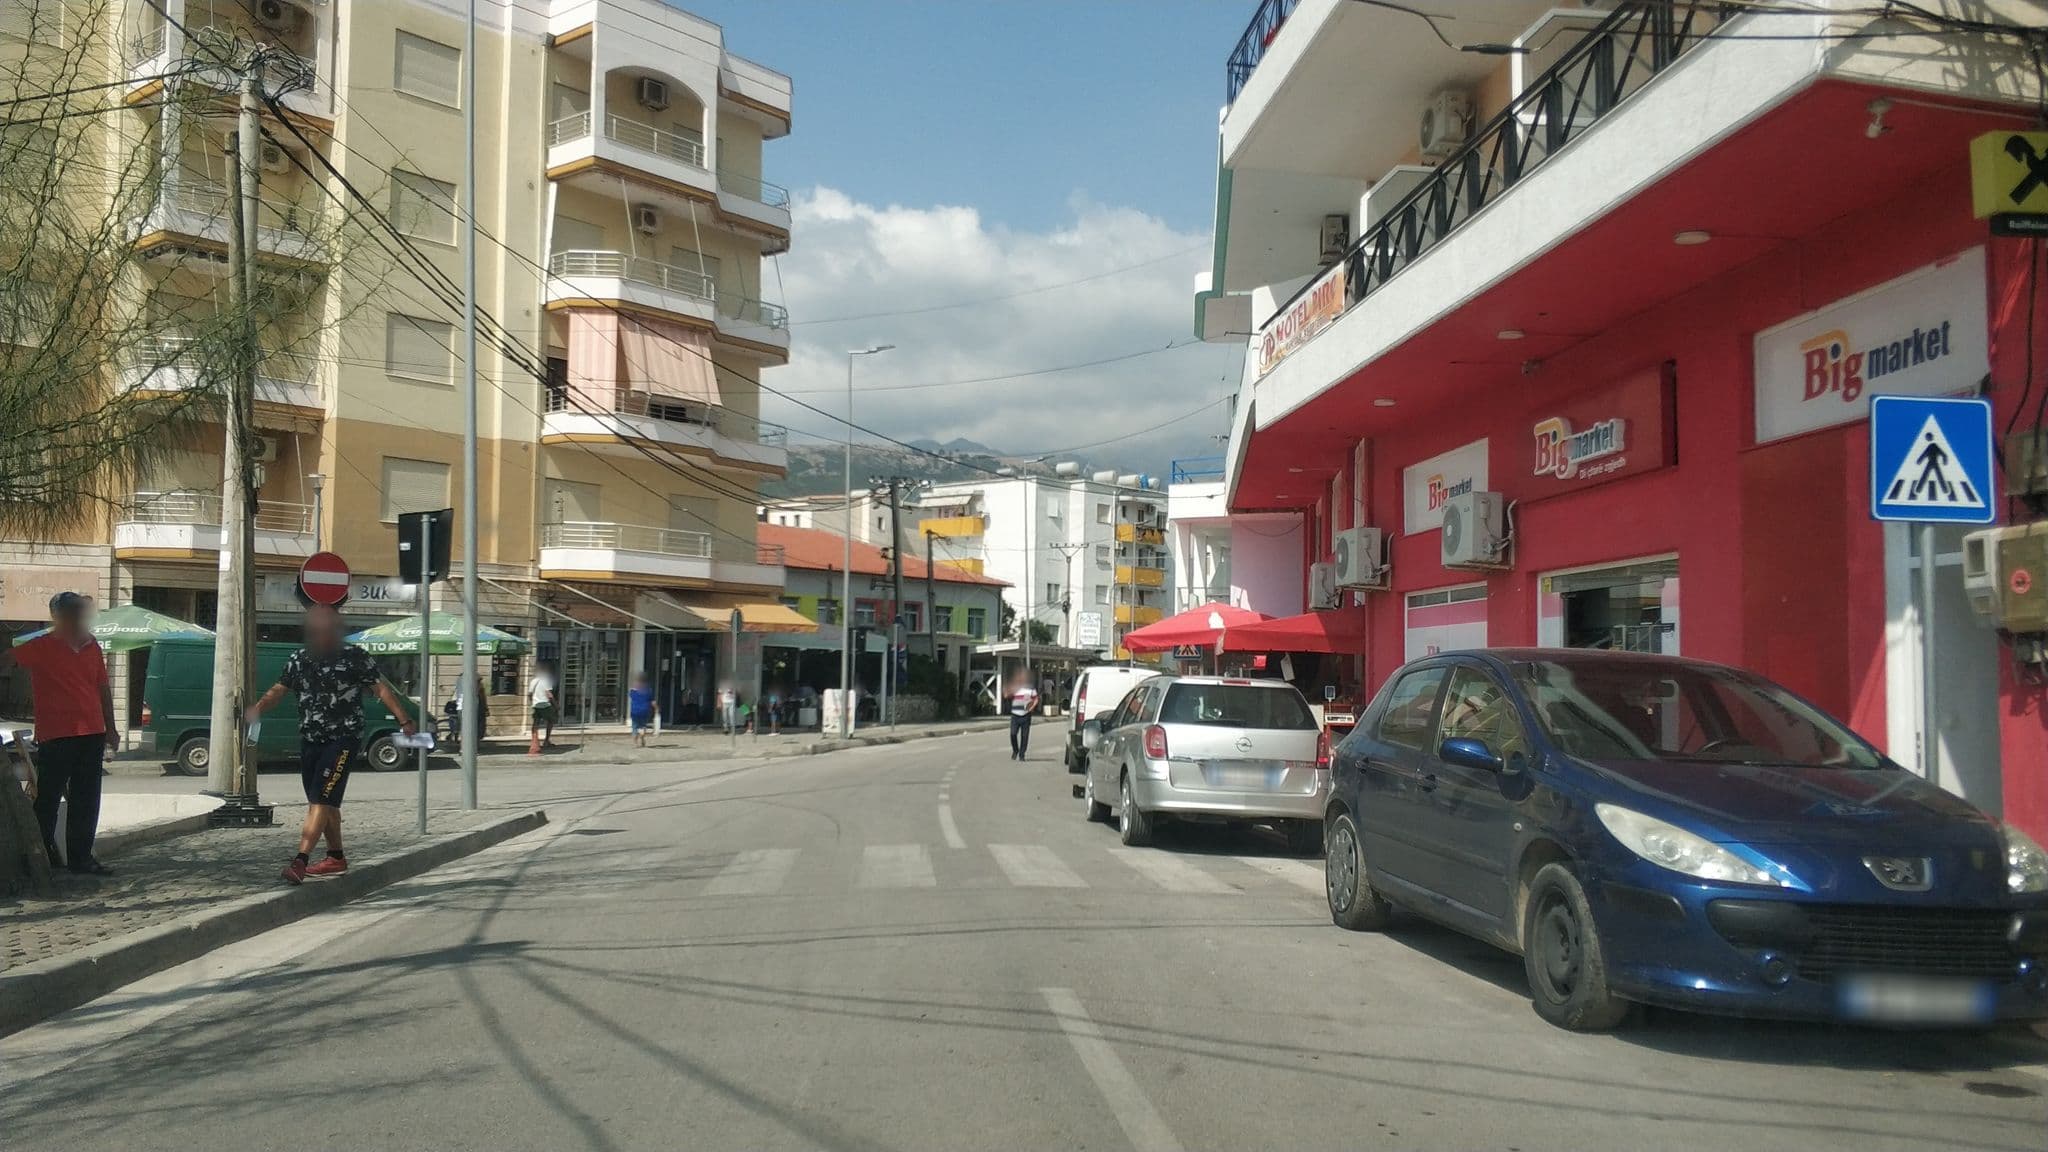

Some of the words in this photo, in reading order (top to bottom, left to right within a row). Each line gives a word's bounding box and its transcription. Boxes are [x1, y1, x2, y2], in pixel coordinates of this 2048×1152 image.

[1802, 337, 1865, 403] Big
[1868, 319, 1951, 380] market
[1534, 420, 1570, 478] Big
[1570, 421, 1615, 461] market
[372, 642, 387, 651] TO
[388, 641, 418, 651] MORE
